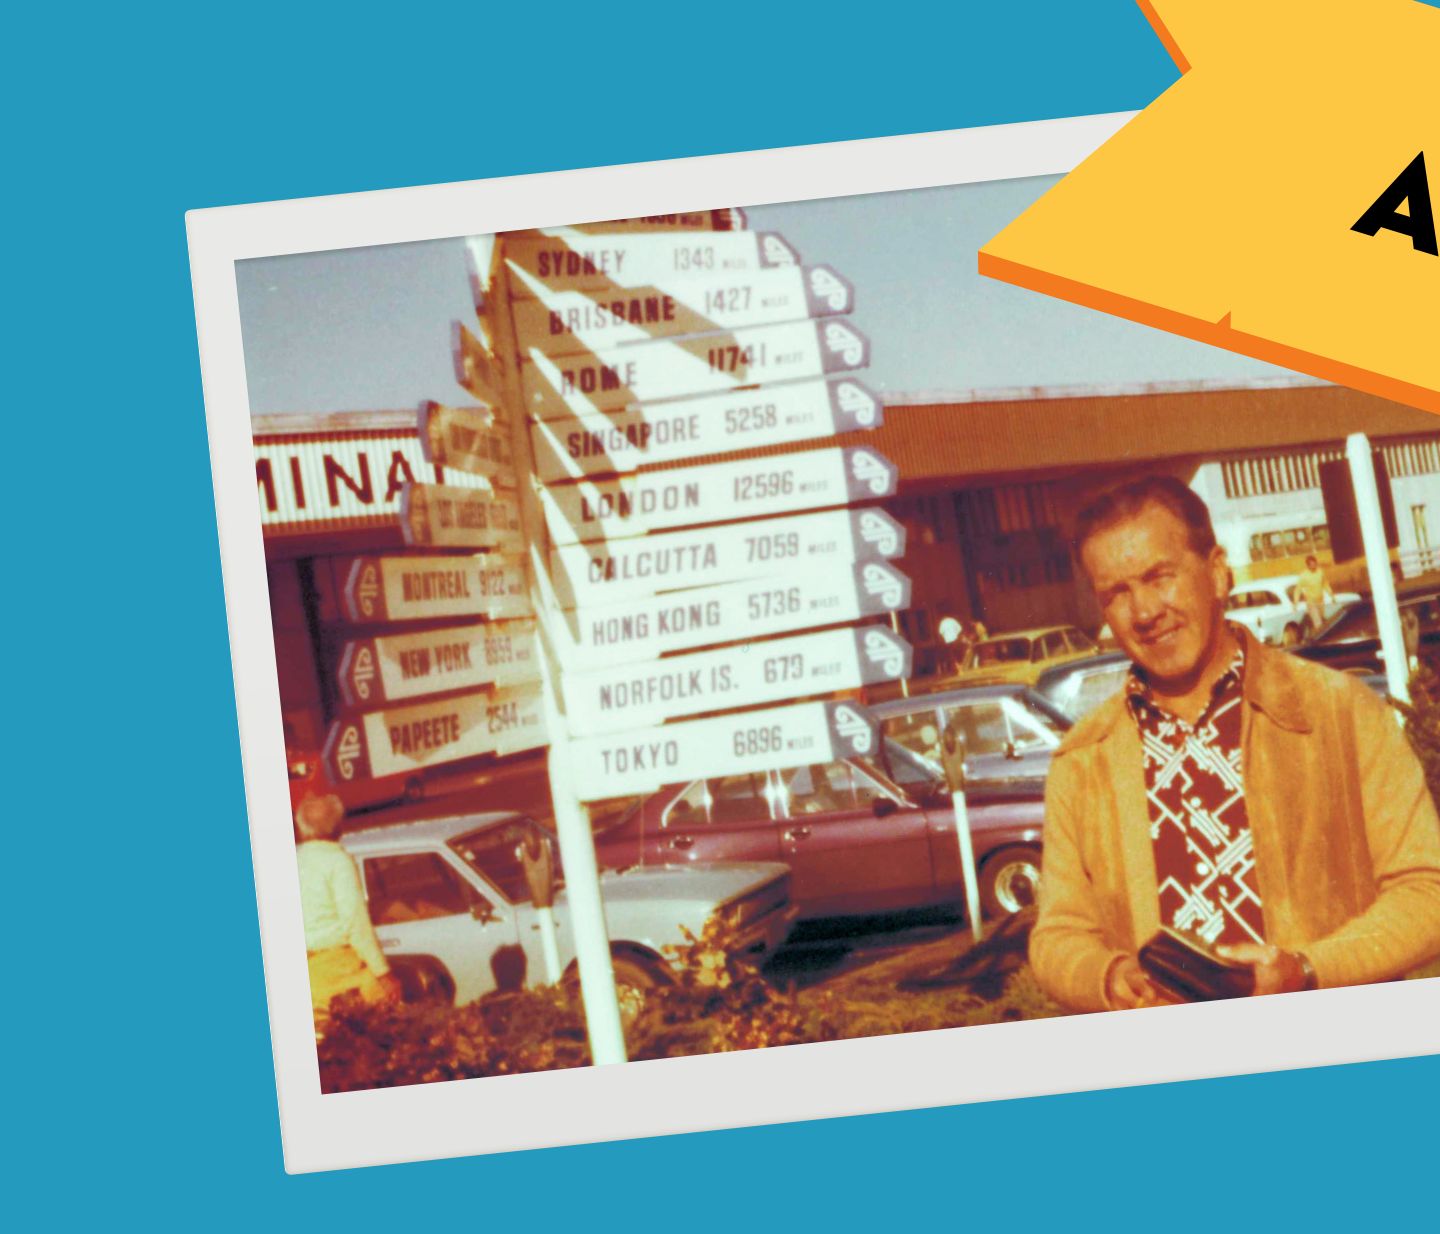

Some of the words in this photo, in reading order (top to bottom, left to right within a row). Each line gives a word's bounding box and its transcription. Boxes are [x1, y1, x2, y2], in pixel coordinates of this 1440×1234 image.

[538, 249, 627, 277] SYDNEY
[674, 247, 715, 271] 1343
[549, 295, 675, 335] BRISBANE
[705, 287, 752, 314] 1427
[561, 362, 637, 395] ROME
[709, 343, 766, 373] 11741
[567, 415, 700, 459] SINGAPORE
[725, 405, 777, 435] 5258
[581, 482, 700, 523] LONDON
[734, 471, 794, 502] 12596
[588, 543, 717, 585] CALCUTTA
[744, 533, 799, 562] 7059
[402, 570, 470, 602] MONTREAL
[593, 615, 648, 645] HONG
[658, 602, 720, 635] KONG
[748, 588, 801, 620] 5736
[400, 648, 430, 680] NEW
[434, 642, 472, 673] YORK
[600, 670, 702, 710] NORFOLK
[711, 665, 739, 691] IS.
[763, 654, 804, 684] 673
[390, 713, 460, 756] PAPEETE
[602, 741, 678, 775] TOKYO
[733, 726, 782, 758] 6896
